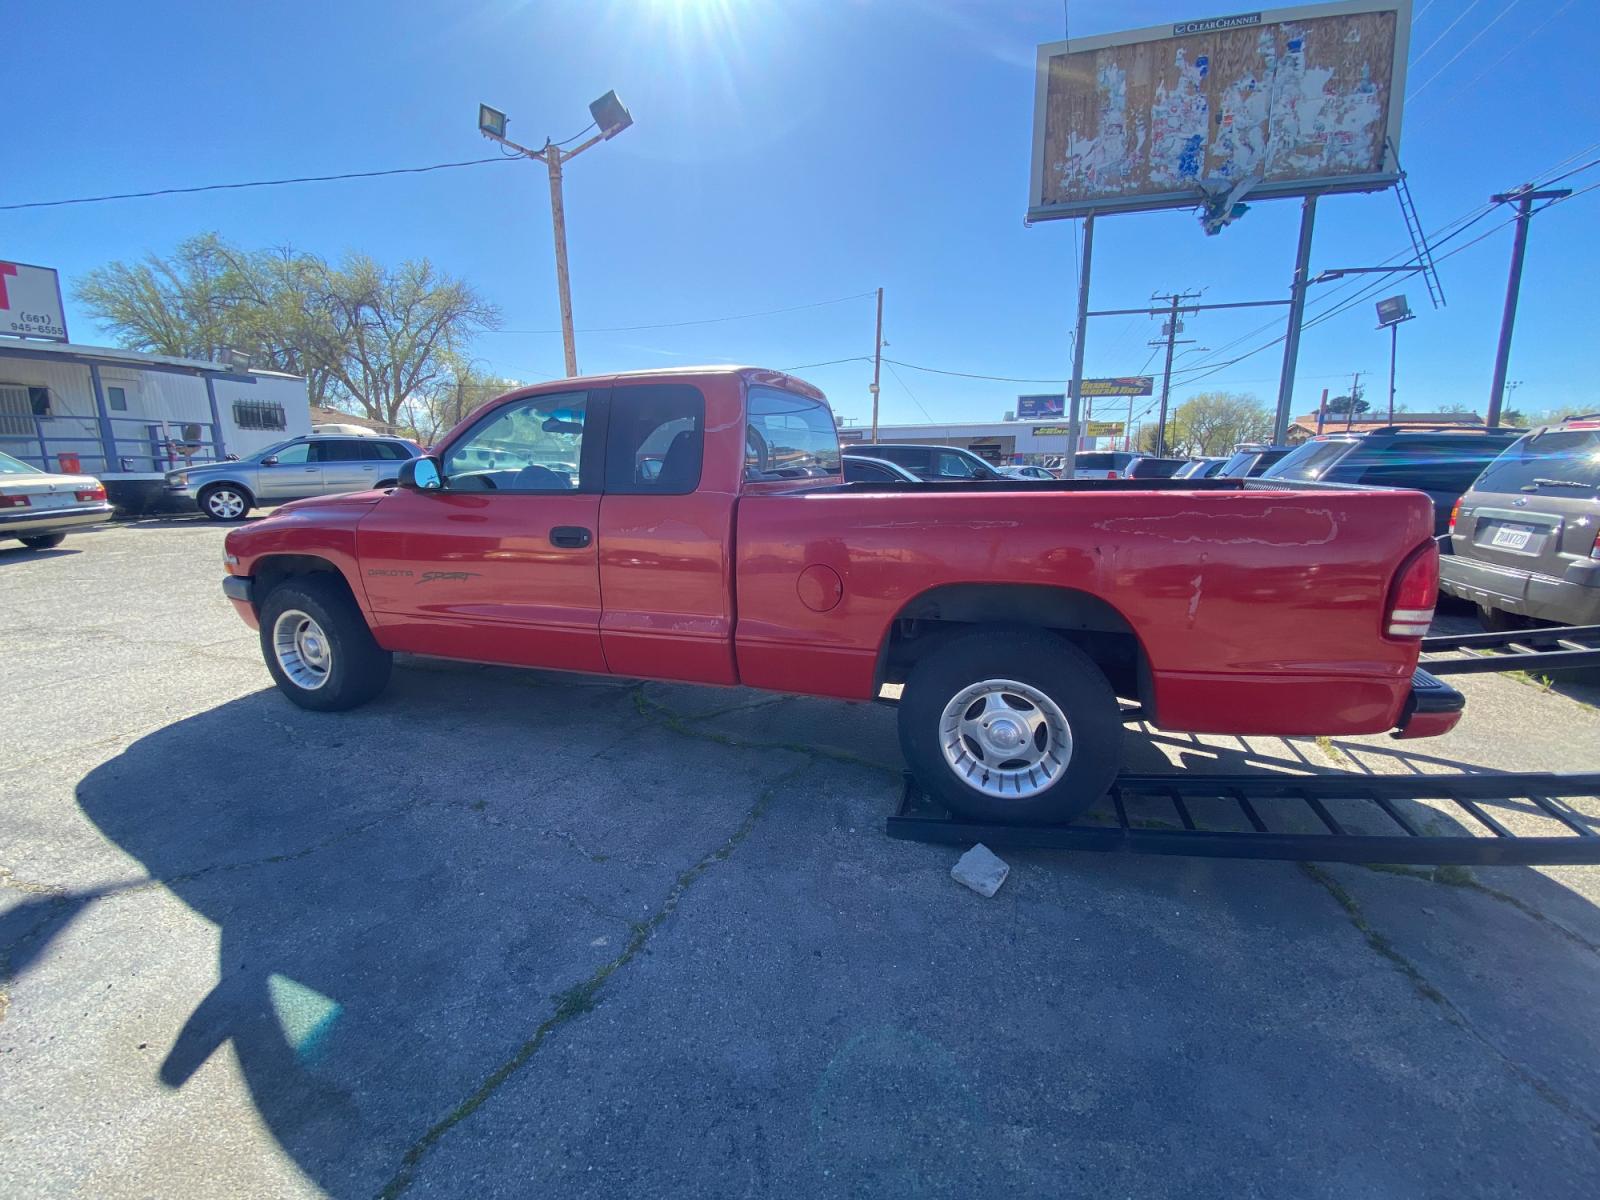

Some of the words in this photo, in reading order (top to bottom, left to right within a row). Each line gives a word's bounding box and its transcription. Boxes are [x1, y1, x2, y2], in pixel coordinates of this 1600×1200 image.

[20, 311, 52, 325] (661)
[10, 322, 64, 335] 945-6555
[367, 569, 414, 577] DAKOTA
[415, 571, 484, 585] SPORT
